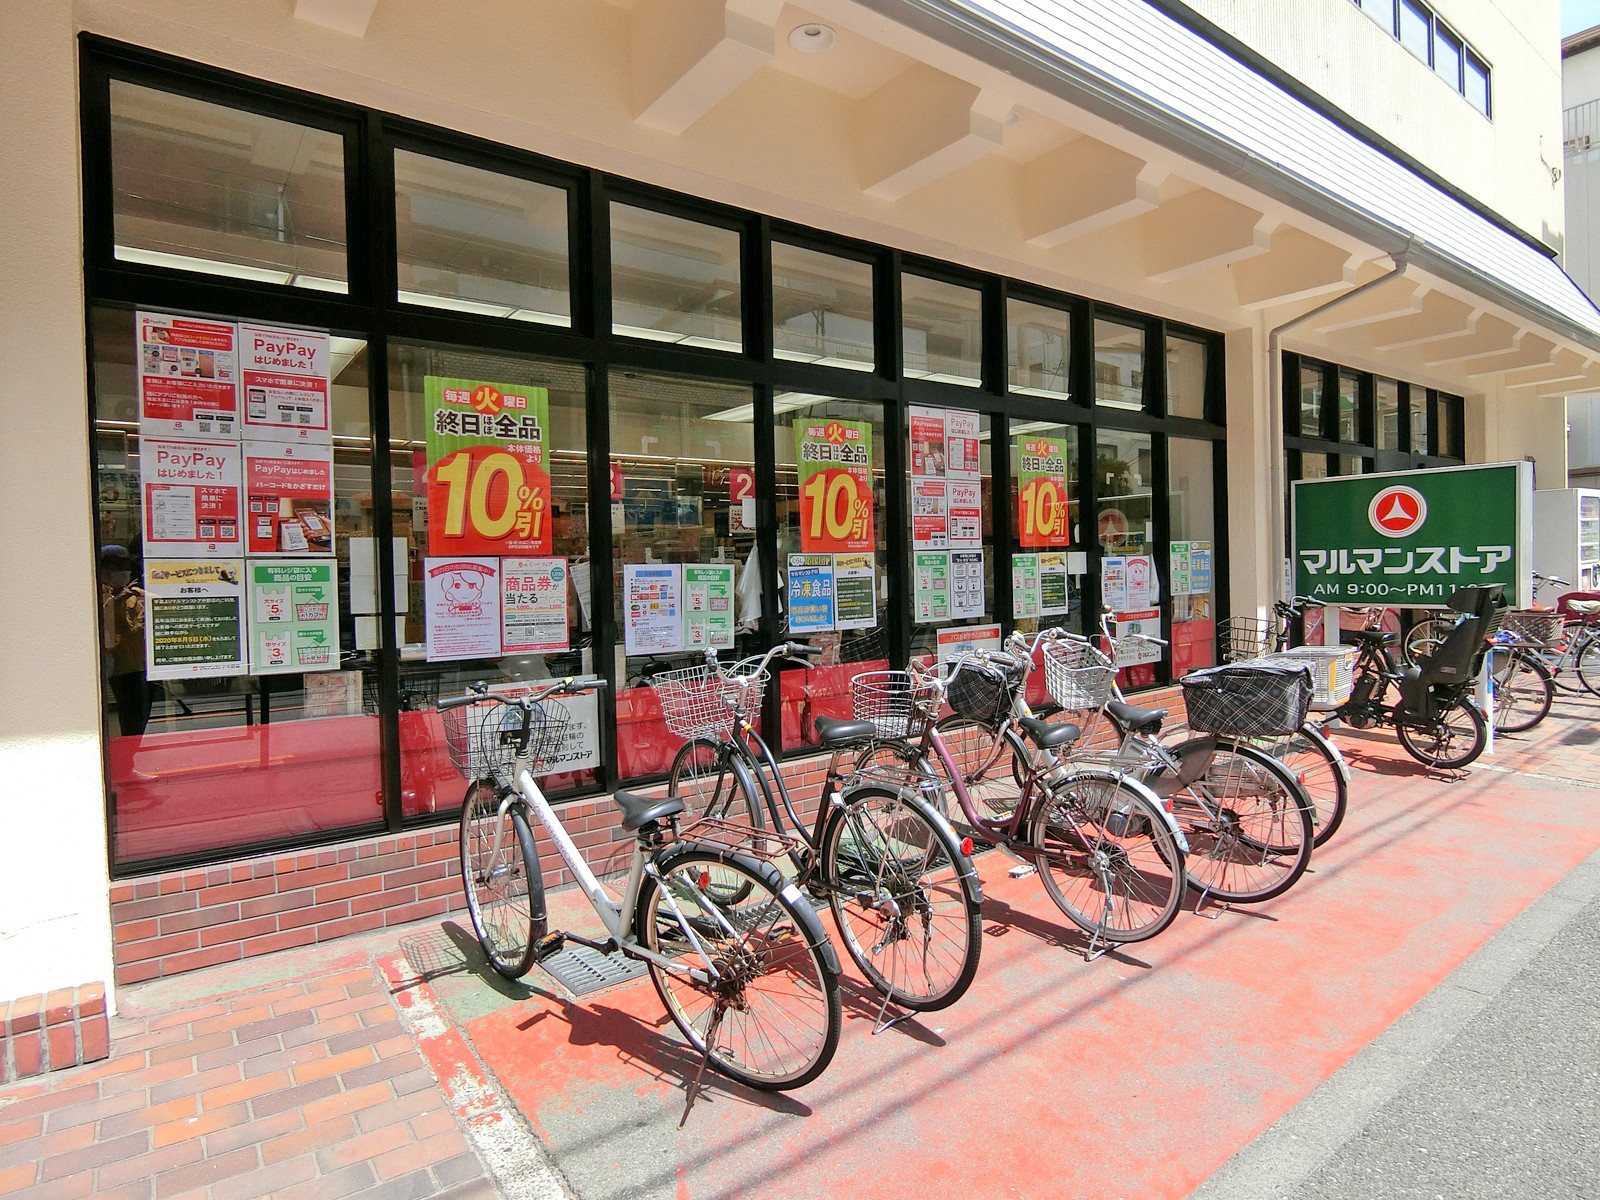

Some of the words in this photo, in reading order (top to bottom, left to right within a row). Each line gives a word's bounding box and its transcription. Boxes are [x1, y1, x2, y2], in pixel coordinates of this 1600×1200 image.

[254, 339, 317, 360] PayPay
[254, 356, 314, 370] はじめました！
[255, 376, 318, 389] スマホで簡単に決済！
[444, 388, 527, 413] 毎週火曜日
[436, 410, 541, 441] 終日ほぼ全品
[951, 418, 975, 429] PayPay
[507, 444, 541, 455] 本体価格
[157, 451, 226, 471] PayPay
[526, 454, 541, 463] より
[157, 468, 223, 480] はじめました！
[255, 464, 326, 476] PayPayはじめました
[201, 487, 227, 495] スマホで
[255, 482, 327, 492] バーコードをかざすだけ
[737, 473, 753, 500] 2
[952, 488, 976, 498] PayPay
[1299, 545, 1511, 575] マルマンストア
[273, 574, 313, 582] 商品の目安
[505, 576, 560, 592] 商品券が
[790, 580, 832, 598] 冷凍食品
[1314, 584, 1340, 596] AM
[505, 593, 538, 605] 当たる
[546, 750, 592, 764] マルマンストア
